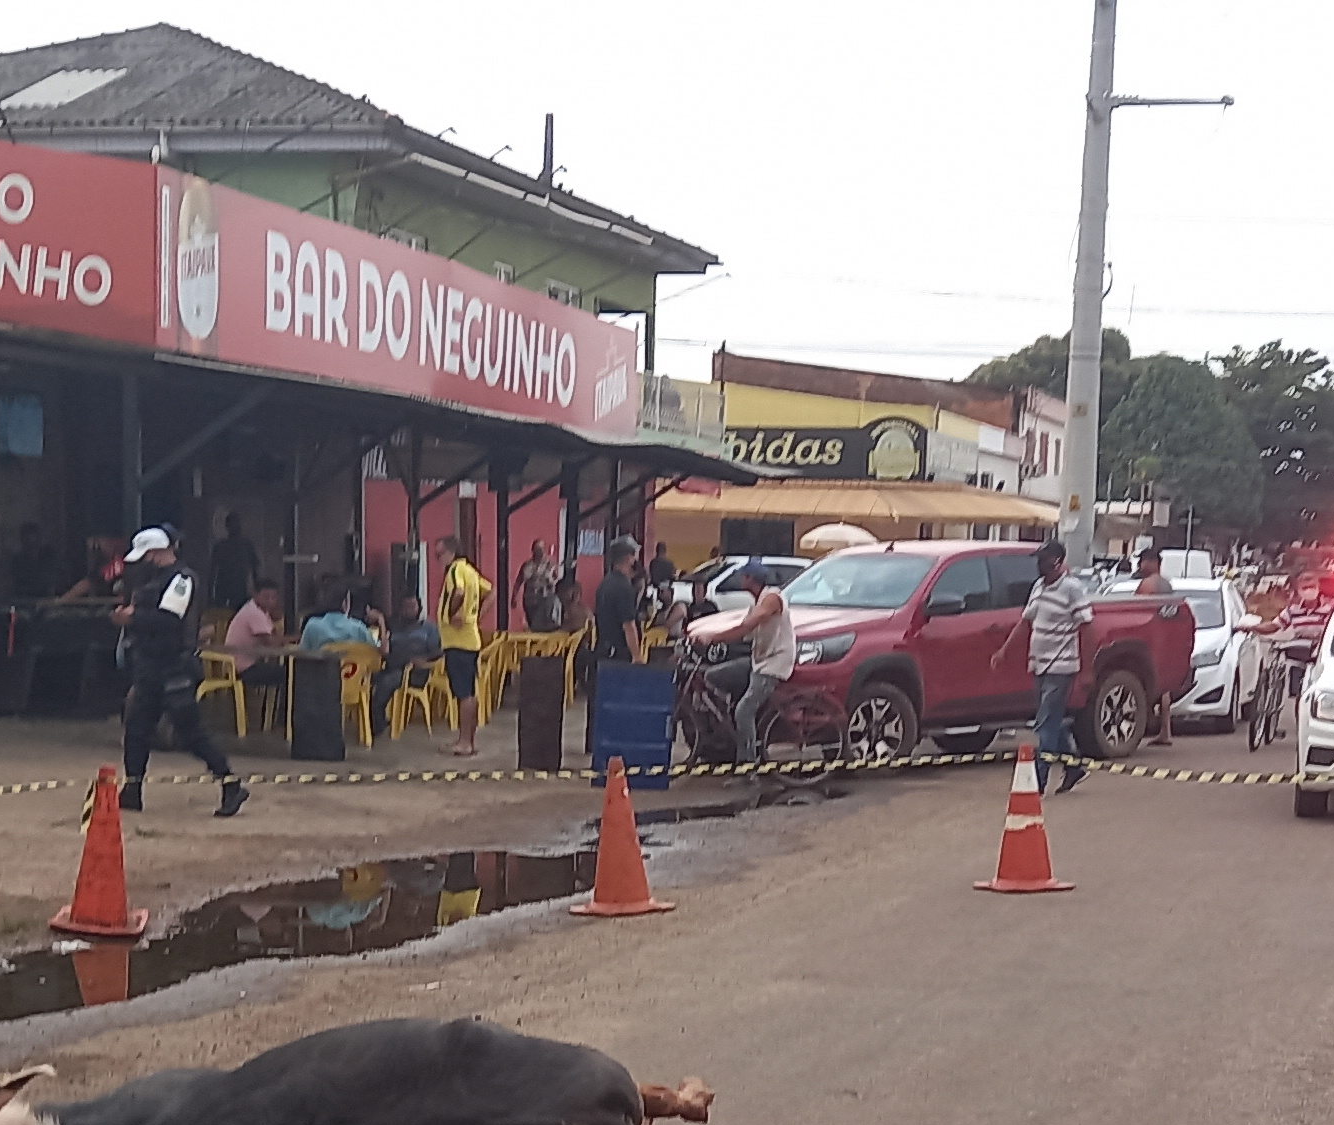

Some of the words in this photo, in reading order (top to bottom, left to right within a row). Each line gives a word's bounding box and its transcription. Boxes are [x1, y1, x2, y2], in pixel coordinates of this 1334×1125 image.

[266, 229, 349, 348] BAR
[359, 258, 412, 362] DO
[419, 277, 576, 409] NEGUINHO
